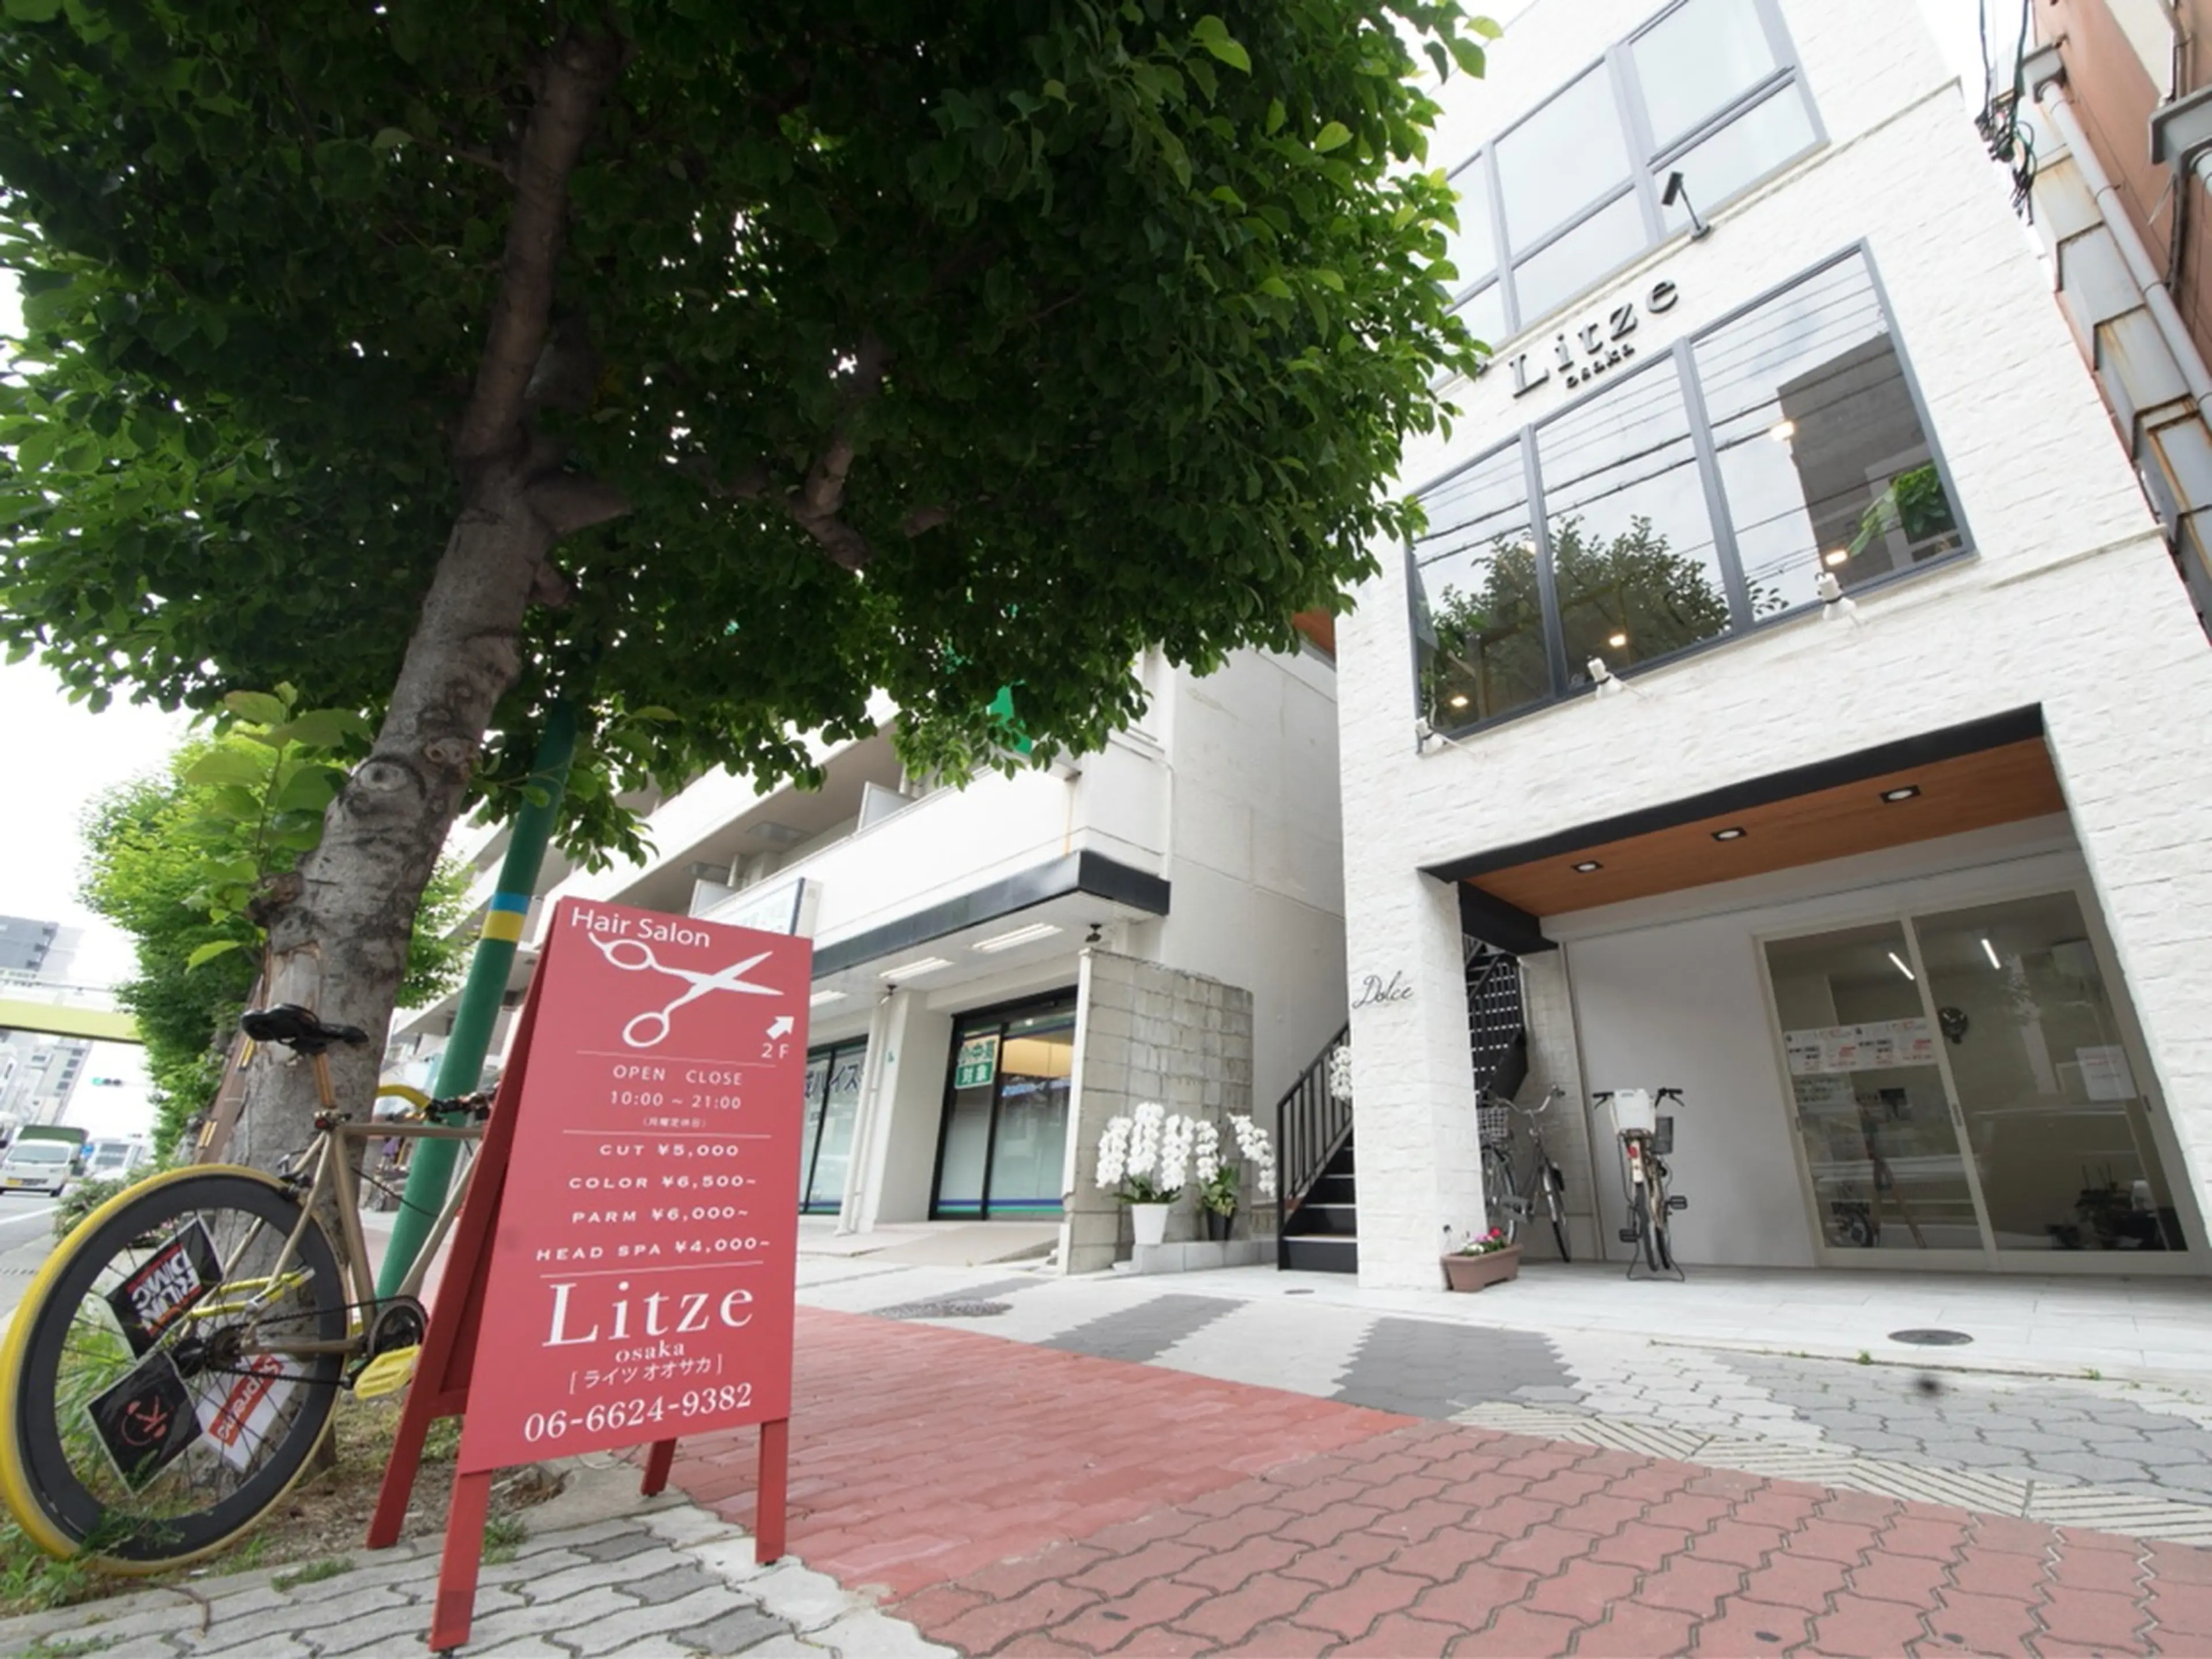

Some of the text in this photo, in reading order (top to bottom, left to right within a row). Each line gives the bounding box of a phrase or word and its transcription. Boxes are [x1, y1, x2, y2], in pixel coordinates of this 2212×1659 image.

[1509, 279, 1679, 399] Litze
[571, 907, 710, 947] Hair Salon
[1351, 969, 1414, 1009] Dolce
[761, 1042, 789, 1059] 2F
[613, 1065, 741, 1086] OPEN CLOSE
[611, 1090, 663, 1107] 10:00
[692, 1094, 741, 1109] 21:00
[599, 1144, 738, 1157] CUT ¥5,000
[569, 1177, 648, 1189] COLOR
[572, 1211, 637, 1223] PARM
[536, 1247, 603, 1261] HEAD
[618, 1244, 660, 1257] SPA
[543, 1281, 754, 1347] Litze
[615, 1340, 684, 1362] osaka
[524, 1382, 752, 1441] 06-6624-9382
